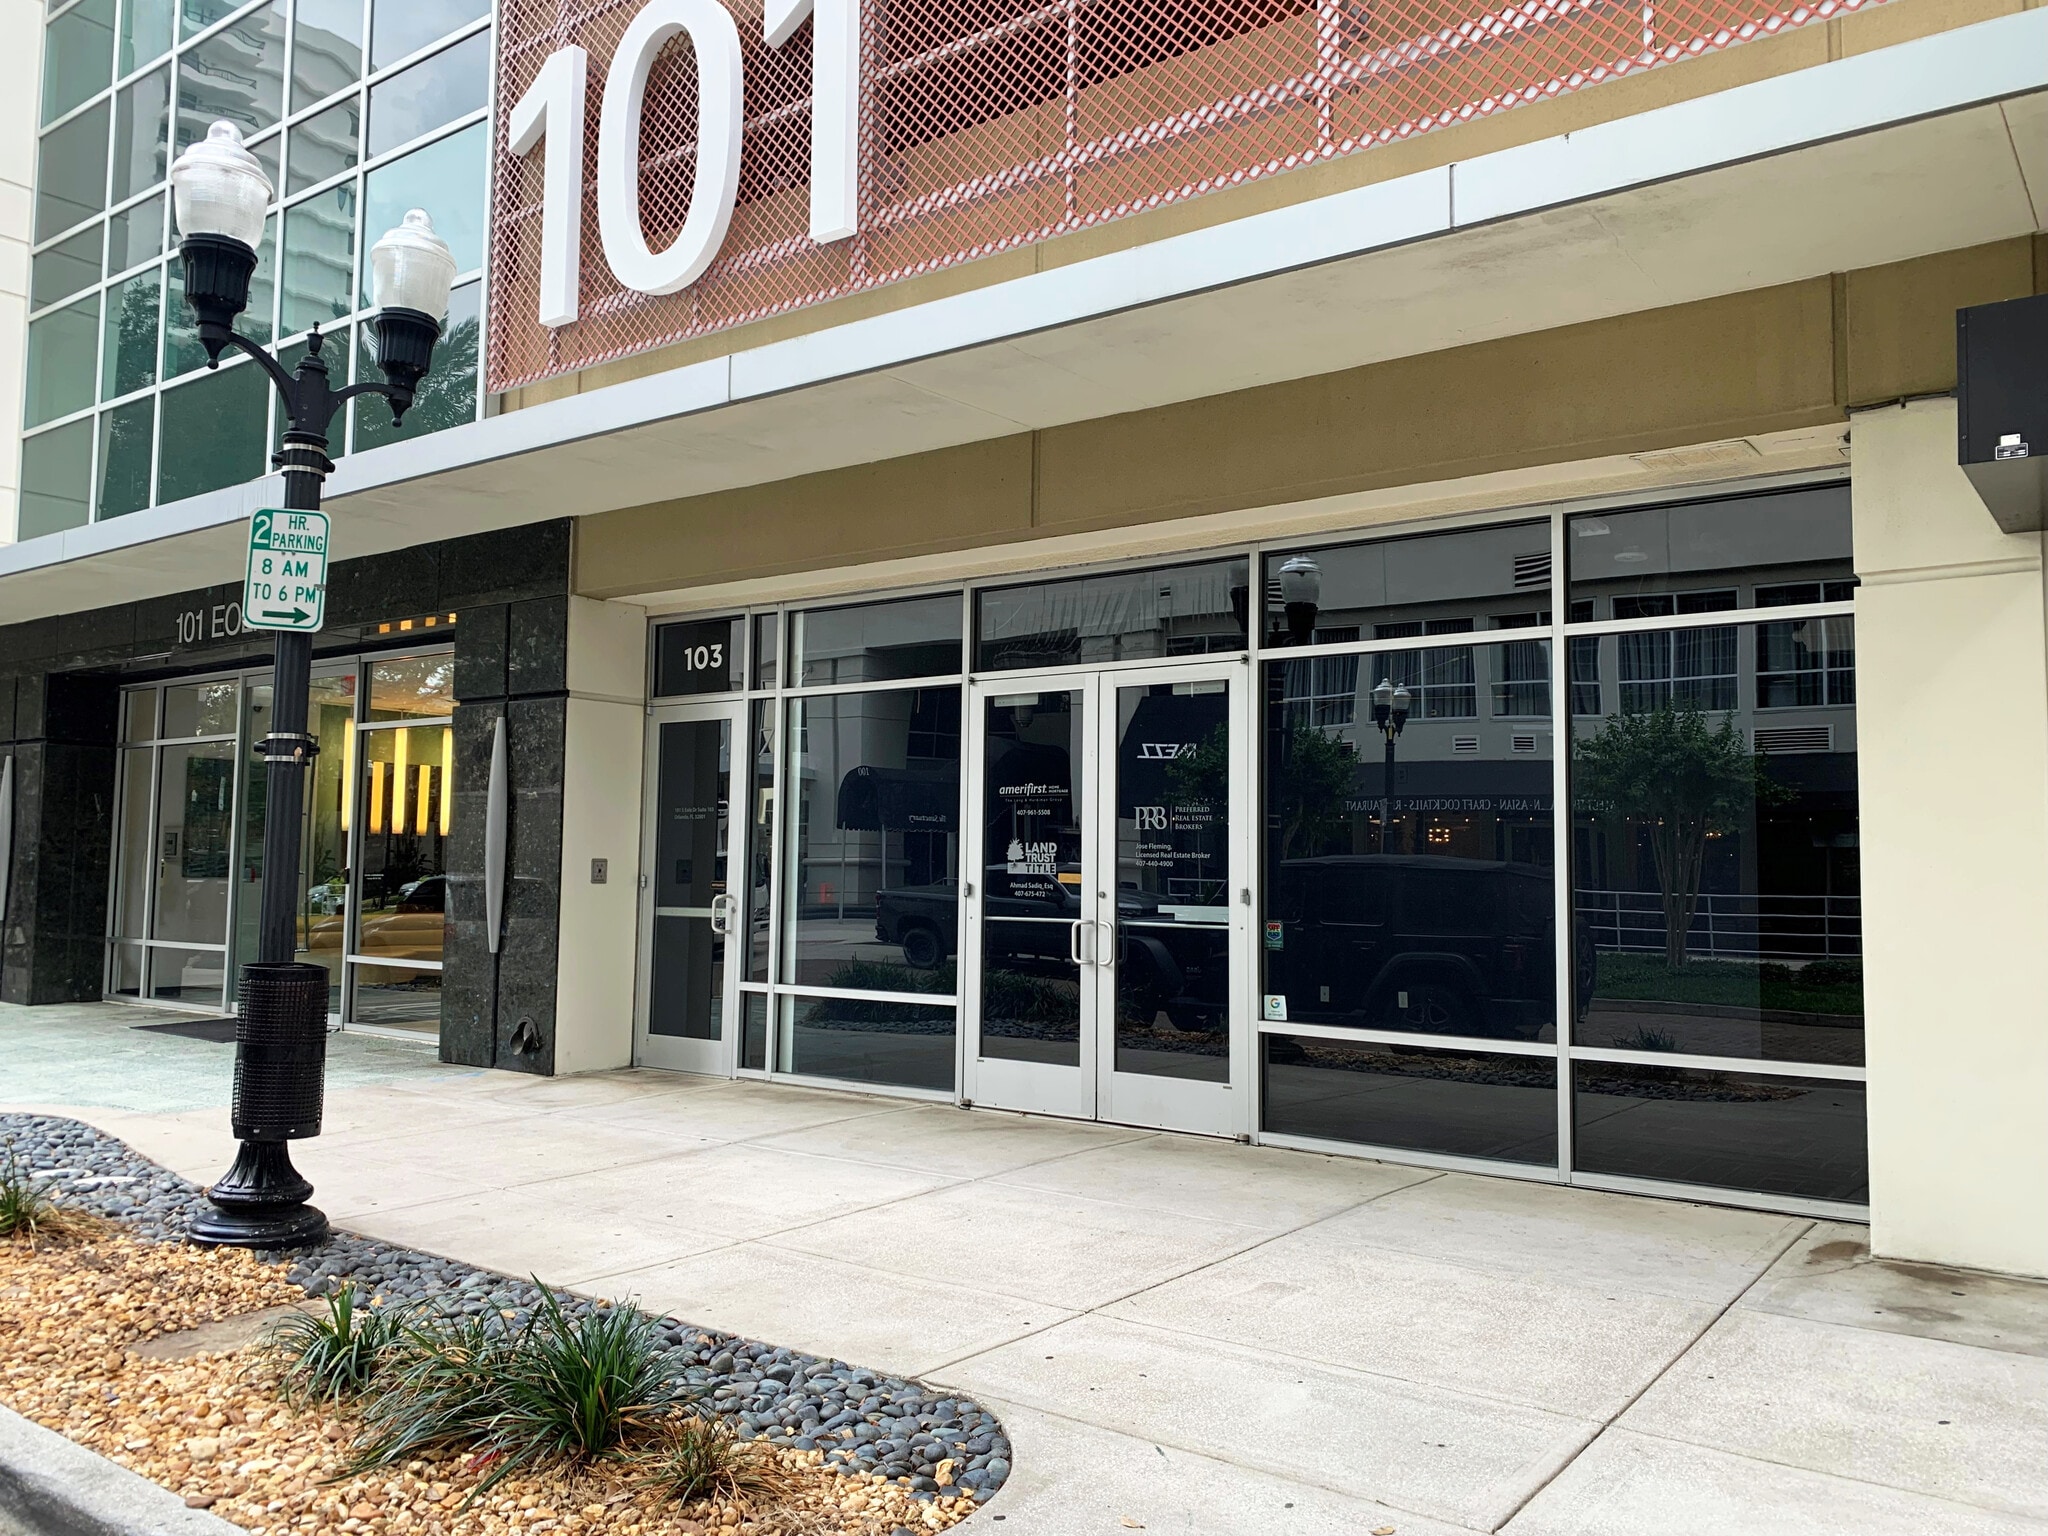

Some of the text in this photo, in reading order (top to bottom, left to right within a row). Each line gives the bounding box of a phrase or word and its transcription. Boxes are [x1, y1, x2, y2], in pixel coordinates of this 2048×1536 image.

[508, 0, 859, 328] 101
[253, 515, 271, 544] 2
[272, 532, 323, 551] PARKING
[262, 558, 309, 578] 8 AM
[253, 582, 317, 604] TO 6 PM
[176, 609, 203, 644] 101
[684, 643, 723, 671] 103
[1025, 842, 1058, 853] LAND
[1025, 853, 1056, 863] TRUST
[1025, 863, 1056, 874] TITLE
